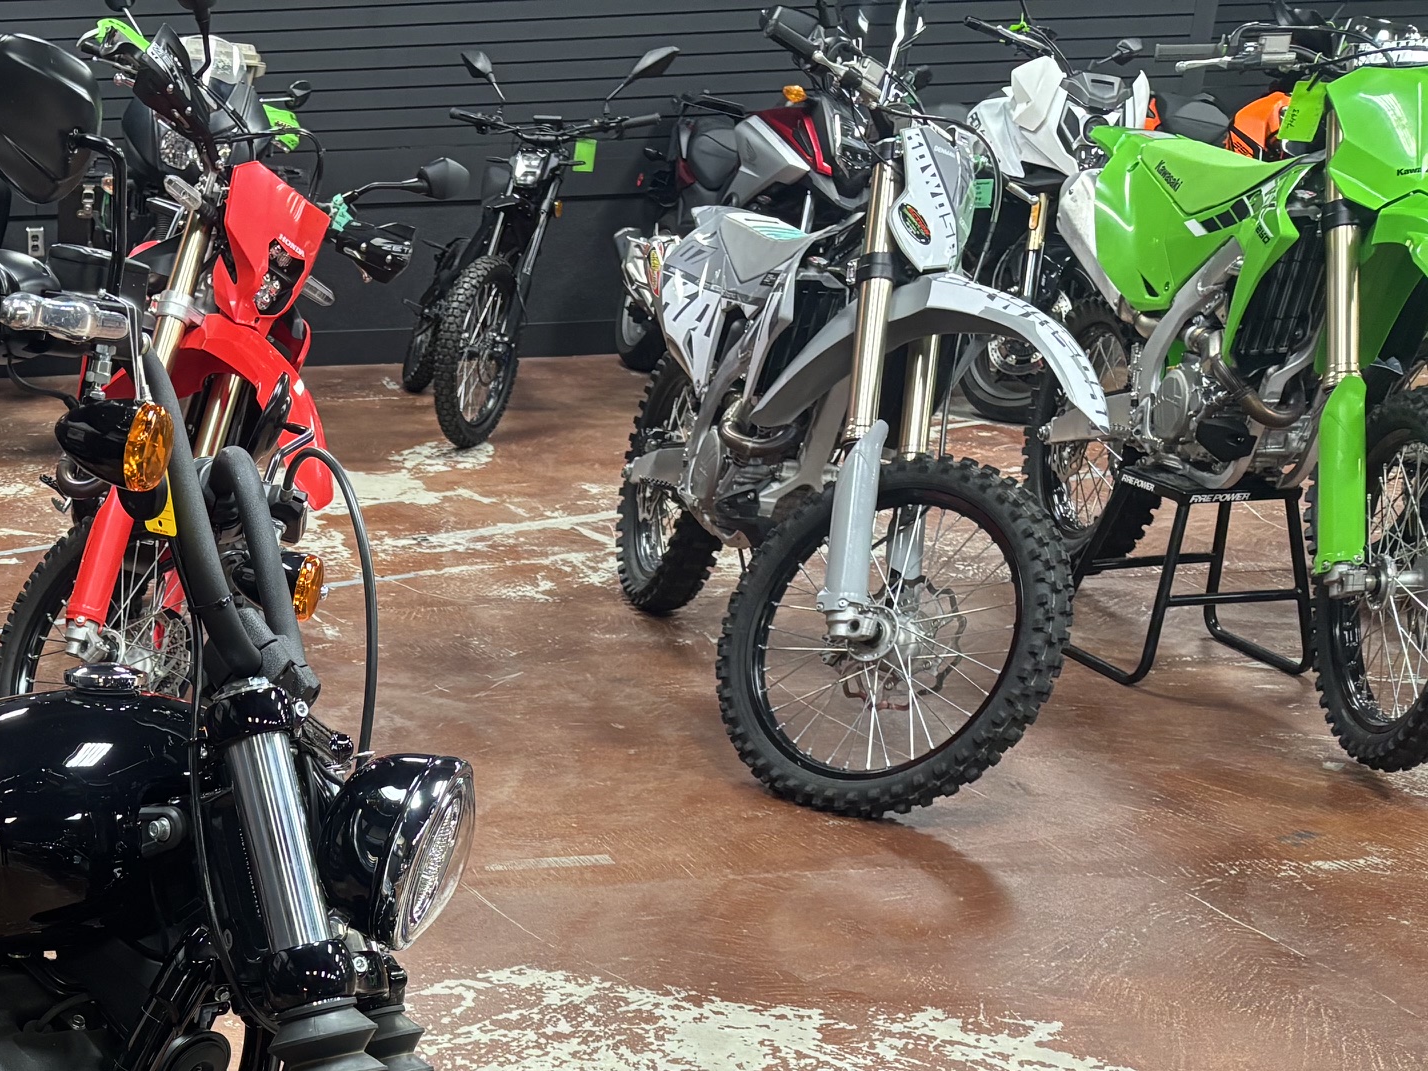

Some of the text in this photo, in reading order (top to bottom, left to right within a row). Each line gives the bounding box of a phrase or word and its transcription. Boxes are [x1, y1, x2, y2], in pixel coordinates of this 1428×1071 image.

[1154, 159, 1183, 192] Kawasaki
[278, 233, 306, 258] HONDA
[1134, 479, 1155, 492] POWER
[1212, 492, 1251, 502] POWER
